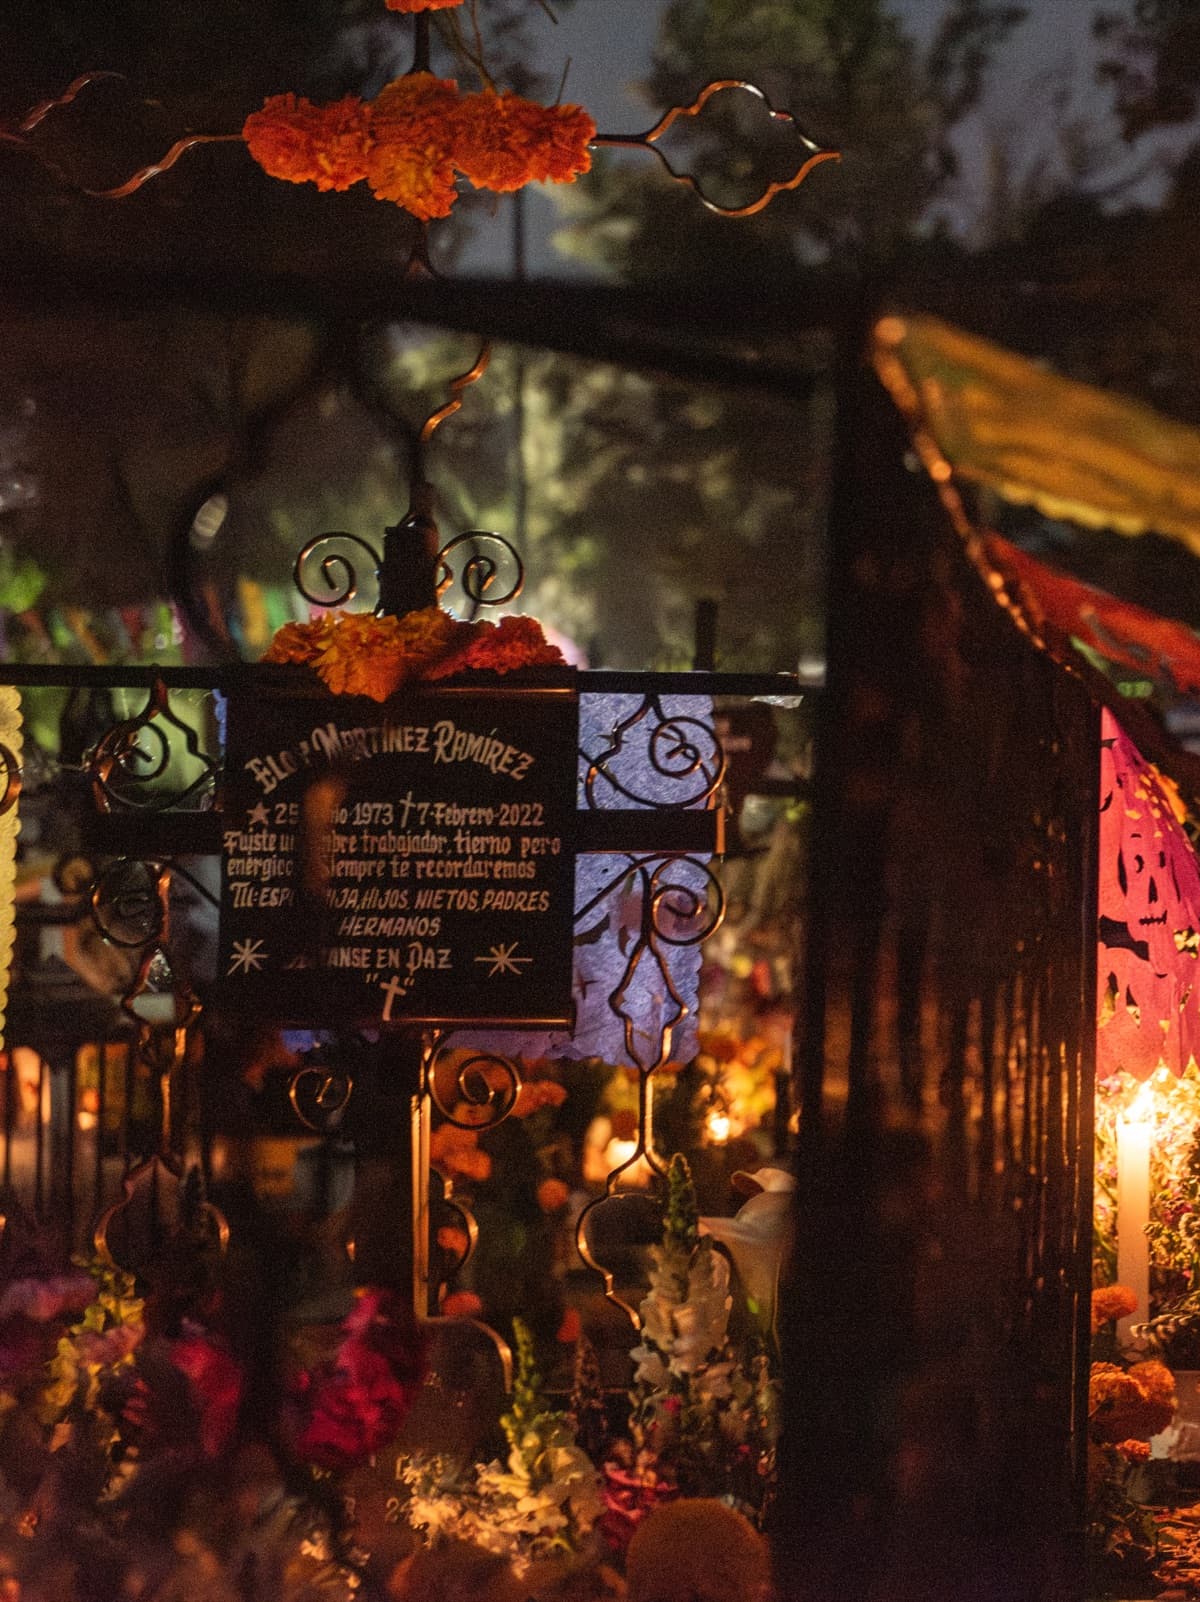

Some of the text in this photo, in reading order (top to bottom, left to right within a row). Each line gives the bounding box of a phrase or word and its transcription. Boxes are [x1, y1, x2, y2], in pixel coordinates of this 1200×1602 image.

[432, 719, 537, 781] RAMÍREZ
[223, 827, 277, 855] Fuiste
[453, 827, 511, 855] tierno
[520, 835, 561, 858] pero
[391, 857, 410, 880] te
[416, 855, 537, 880] recordaremos
[337, 914, 442, 938] HERMANOS
[376, 946, 401, 970] EN
